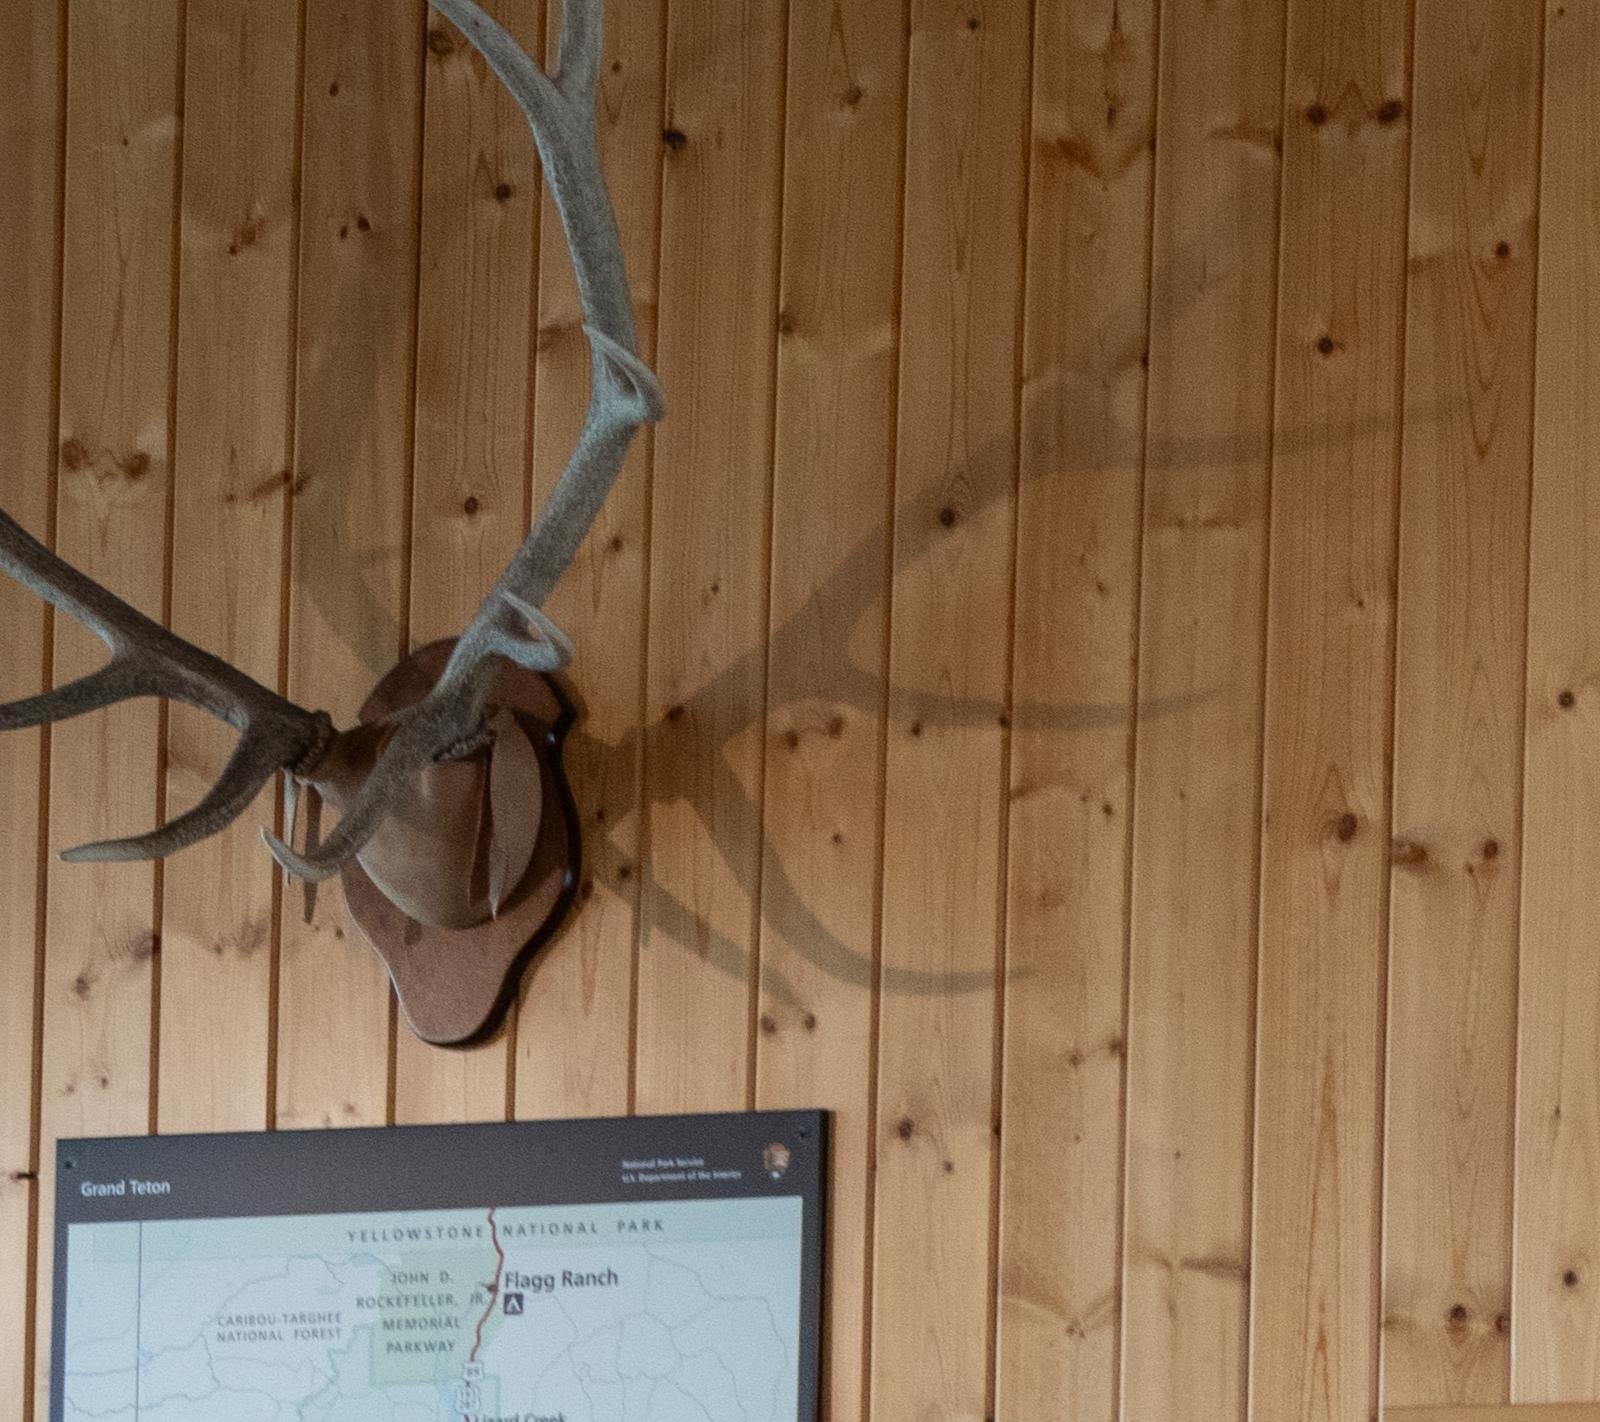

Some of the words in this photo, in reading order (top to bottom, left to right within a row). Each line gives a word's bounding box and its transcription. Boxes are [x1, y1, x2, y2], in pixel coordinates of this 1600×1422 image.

[80, 1181, 125, 1197] Grand
[130, 1179, 171, 1196] Teton
[504, 1271, 555, 1292] Flagg
[562, 1268, 618, 1287] Ranch
